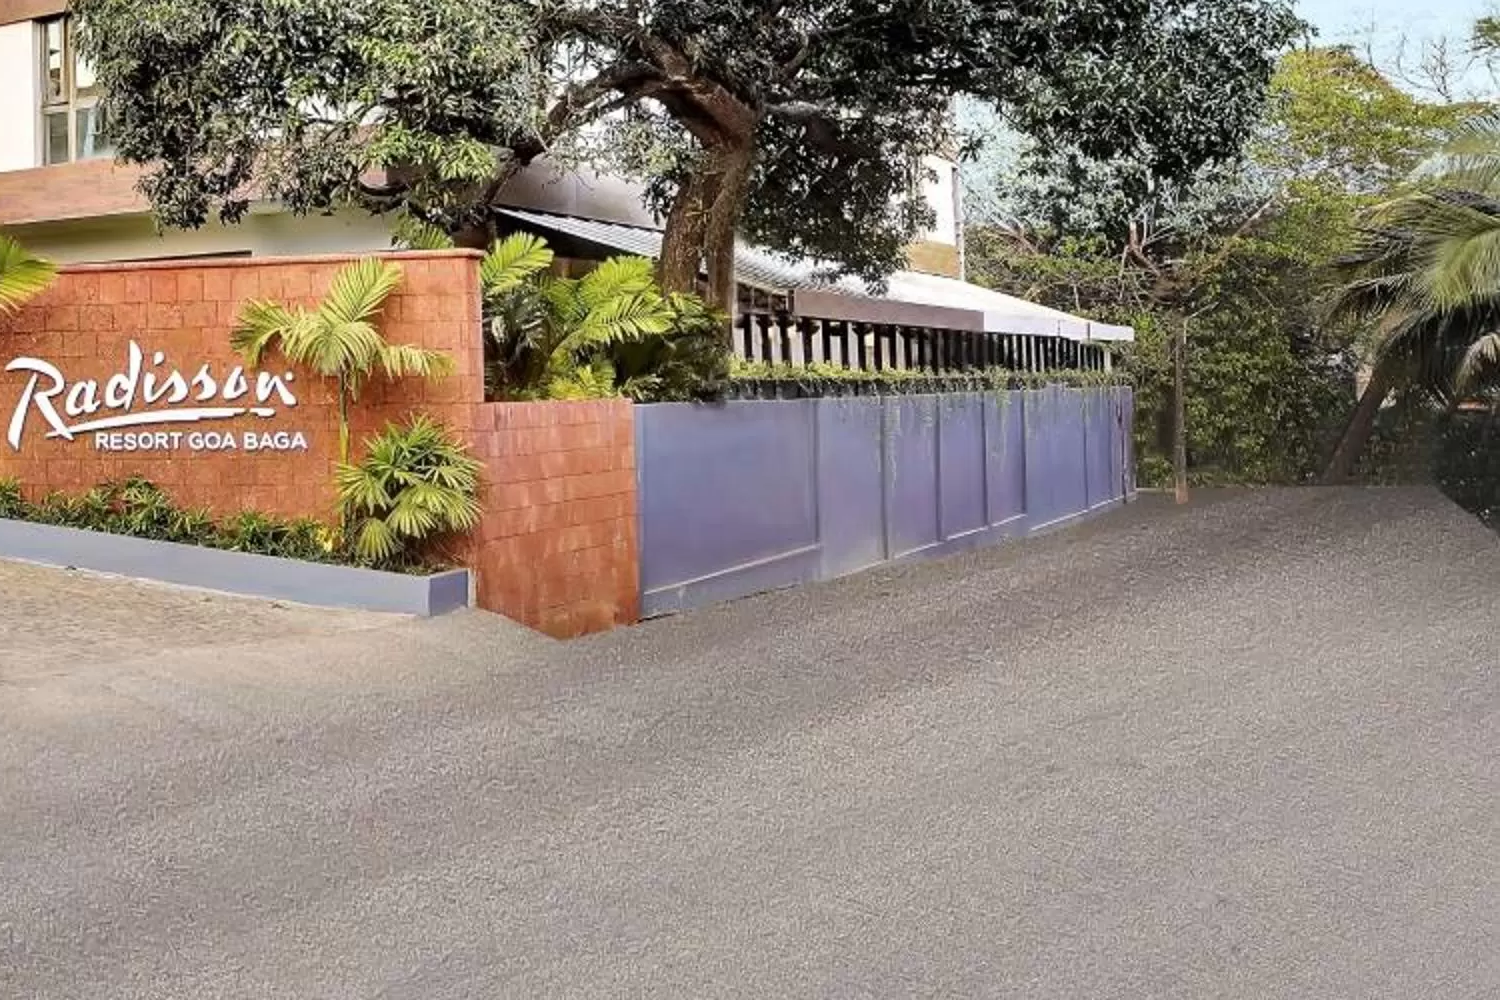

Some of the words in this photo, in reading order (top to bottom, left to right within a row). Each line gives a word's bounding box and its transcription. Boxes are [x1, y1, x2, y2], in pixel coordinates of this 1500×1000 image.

[4, 339, 297, 450] Radisson
[95, 431, 183, 450] RESORT
[189, 431, 237, 450] GOA
[243, 431, 308, 450] BAGA
